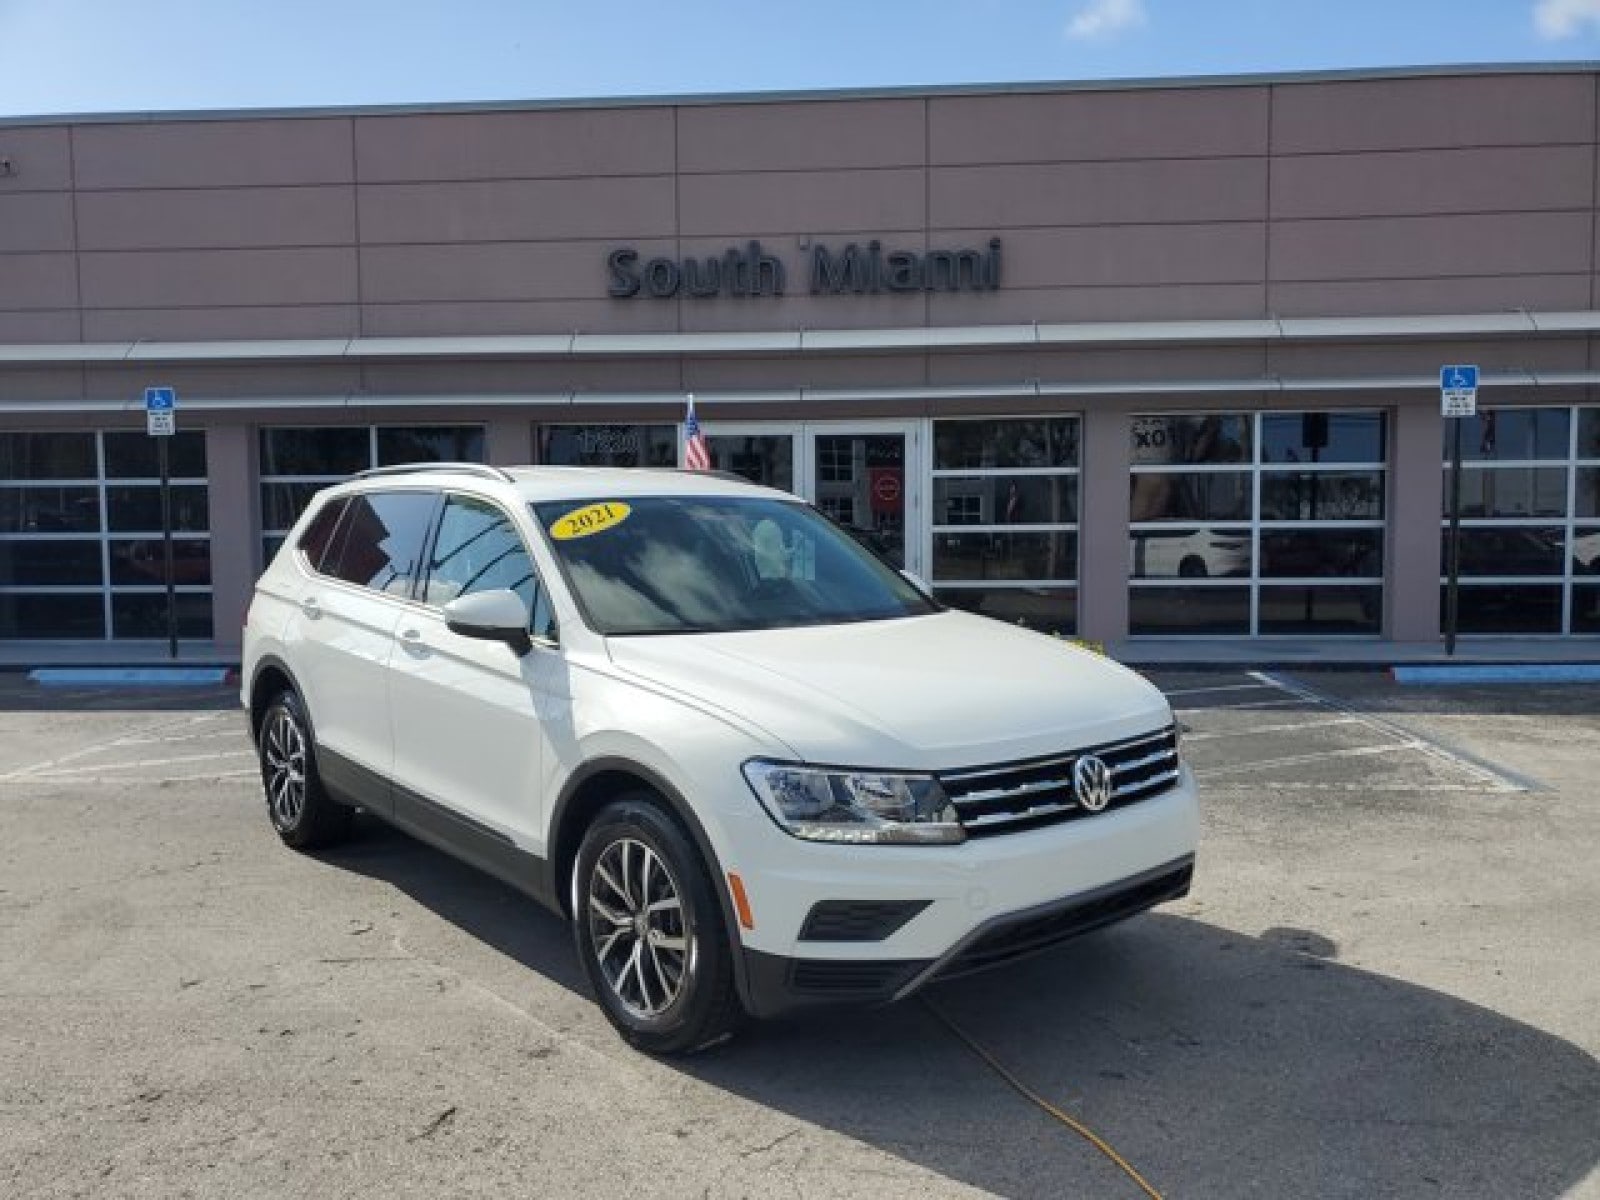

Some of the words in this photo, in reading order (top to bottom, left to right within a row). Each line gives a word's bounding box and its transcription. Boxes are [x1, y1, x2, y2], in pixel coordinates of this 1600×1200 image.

[606, 239, 786, 298] South
[808, 238, 1002, 296] Miami
[565, 504, 615, 535] 2021
